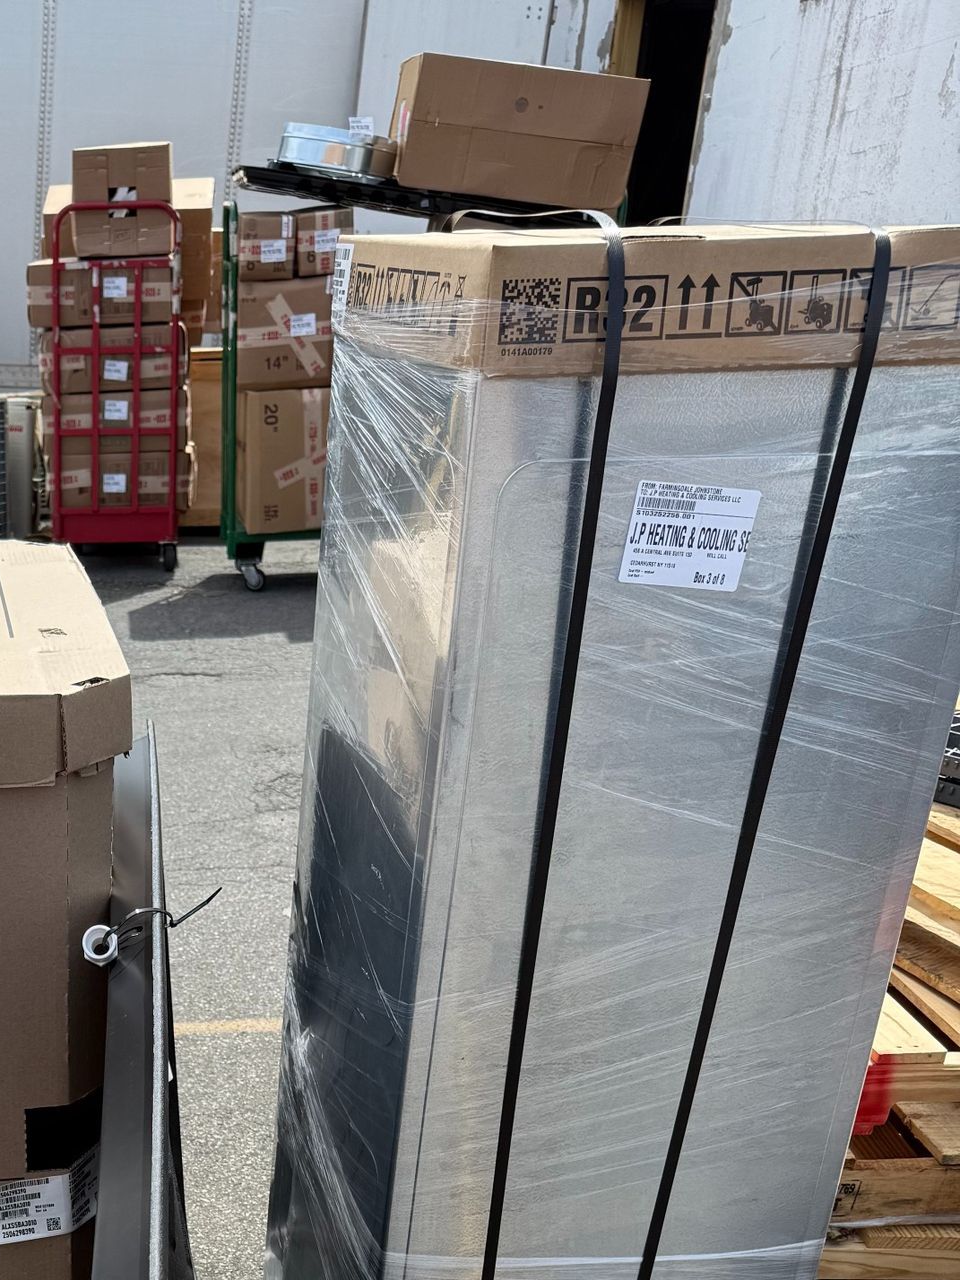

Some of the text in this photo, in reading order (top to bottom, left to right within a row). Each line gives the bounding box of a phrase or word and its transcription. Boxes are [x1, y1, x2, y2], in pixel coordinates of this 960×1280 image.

[575, 284, 657, 334] R2
[501, 347, 553, 357] 0141A00179
[264, 404, 278, 432] 20"
[629, 522, 647, 545] J.P
[646, 523, 688, 548] HEATING
[687, 526, 697, 549] &
[696, 527, 739, 552] COOLING
[693, 572, 726, 585] Box 3 of 8
